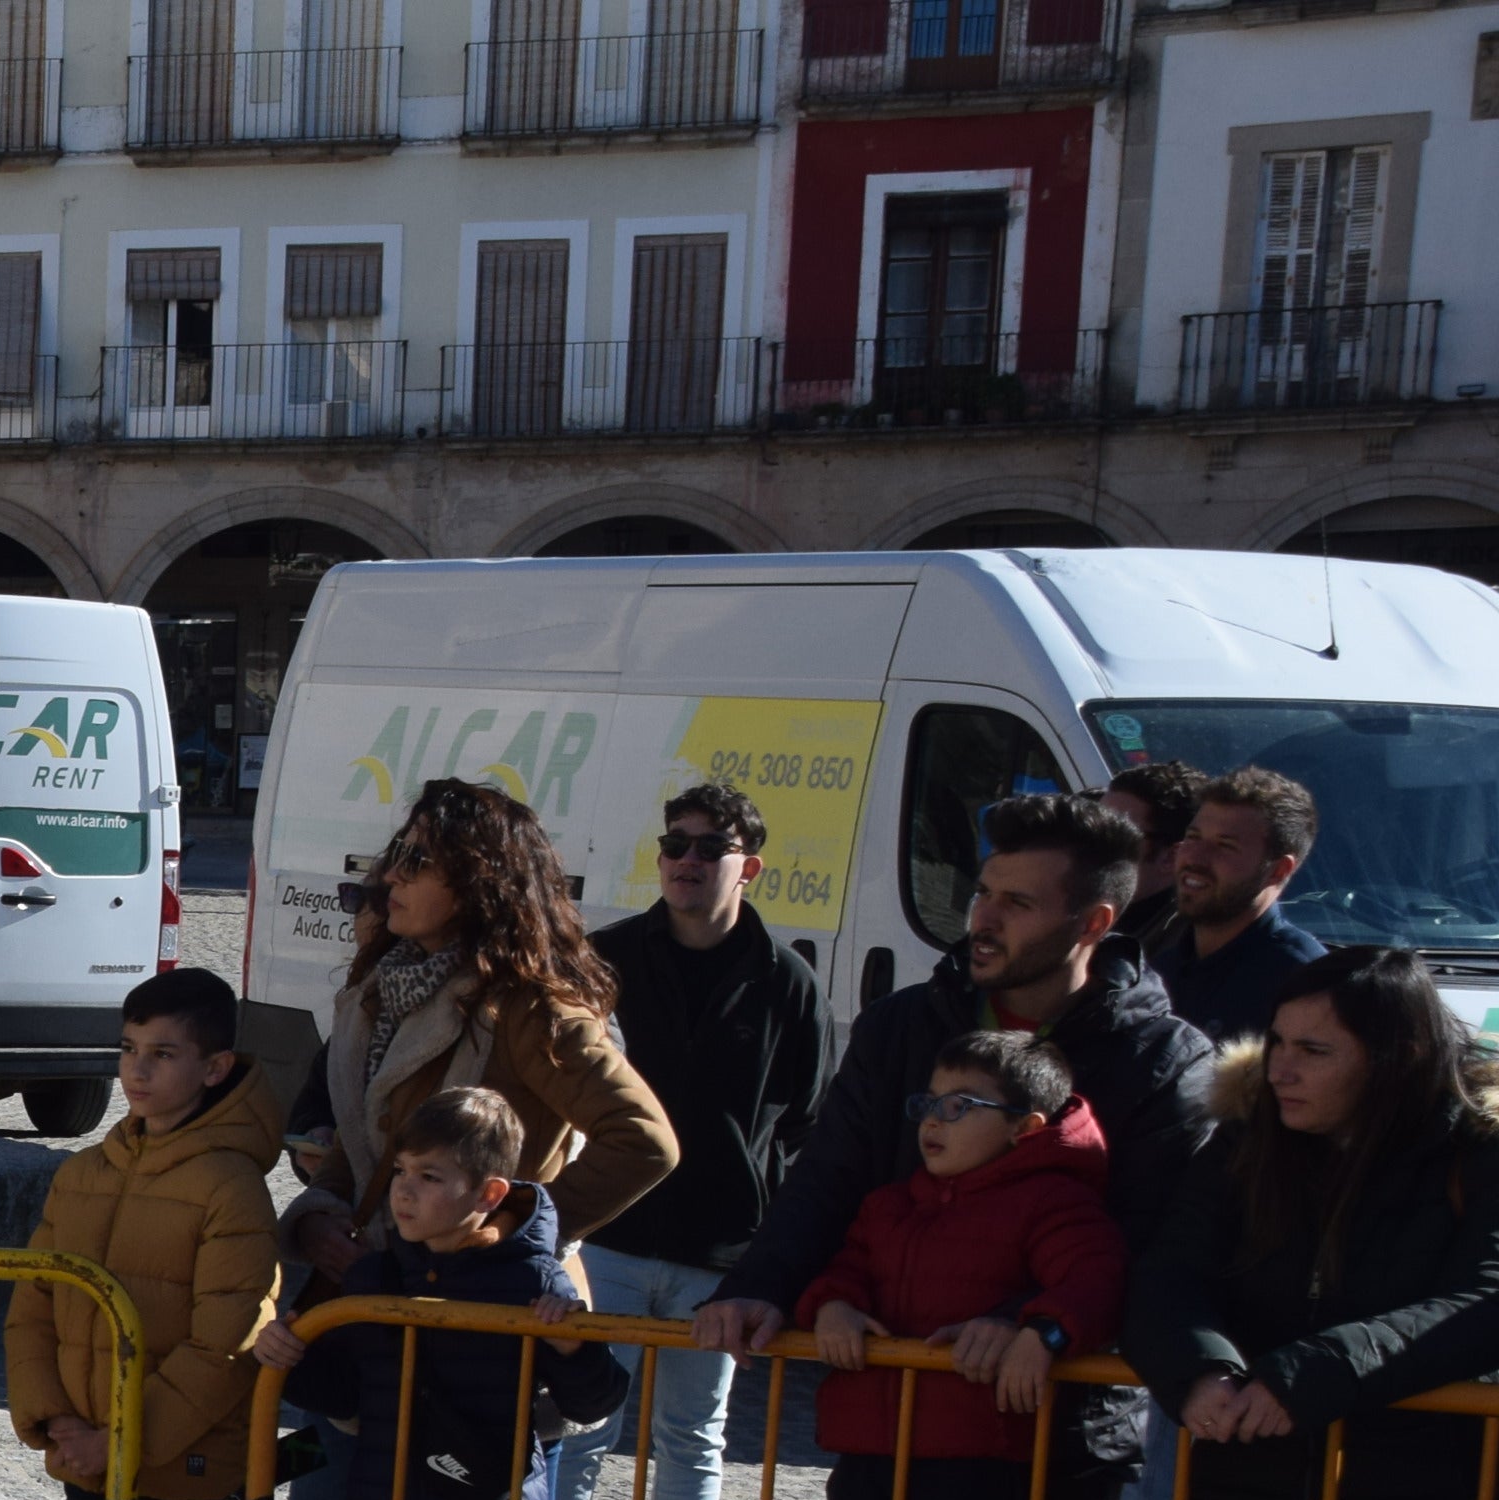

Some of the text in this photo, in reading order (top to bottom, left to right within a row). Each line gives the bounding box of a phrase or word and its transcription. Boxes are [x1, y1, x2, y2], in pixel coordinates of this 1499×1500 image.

[32, 766, 105, 790] RENT
[709, 749, 855, 791] 924 308 850
[36, 813, 128, 830] www.alcar.info
[786, 869, 833, 906] 064
[293, 916, 334, 941] Avda.
[436, 1453, 471, 1477] NIKE
